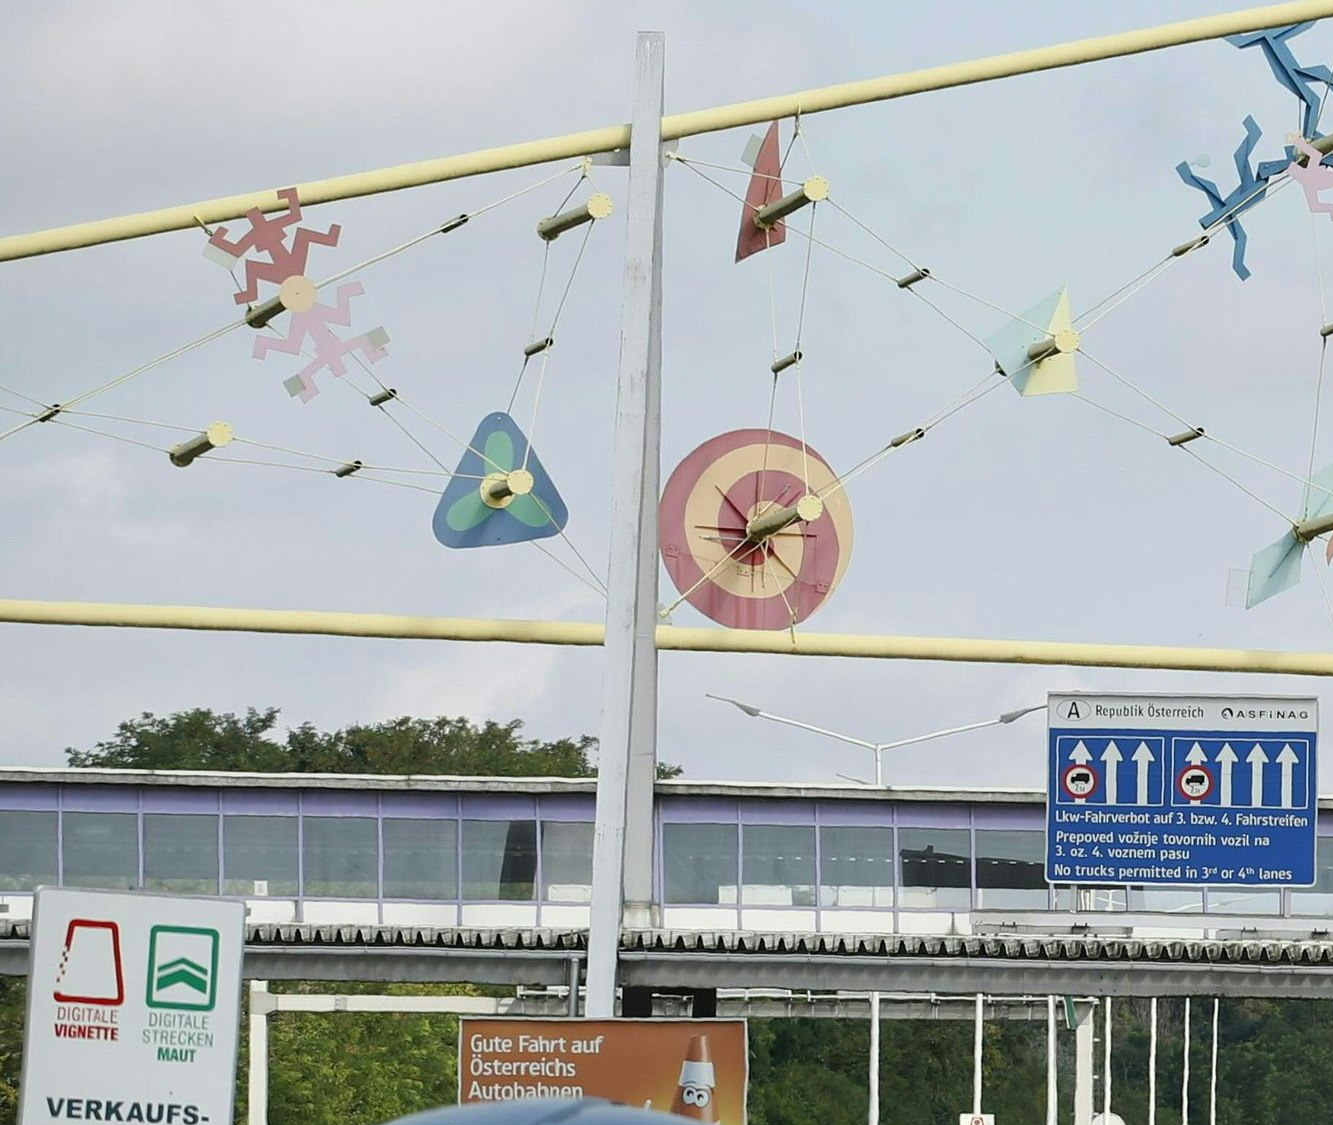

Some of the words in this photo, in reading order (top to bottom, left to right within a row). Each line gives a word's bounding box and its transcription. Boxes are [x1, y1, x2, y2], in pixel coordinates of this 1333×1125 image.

[1067, 701, 1080, 719] A
[1095, 704, 1144, 720] Republik
[1148, 703, 1204, 719] Österreich
[1055, 811, 1151, 824] Lkw-Fahrverbot
[1153, 812, 1173, 825] auf
[1176, 813, 1186, 825] 3.
[1190, 813, 1218, 826] bzw.
[1220, 813, 1232, 826] 4.
[1236, 813, 1309, 827] Fahrstreifen
[1056, 831, 1114, 846] Prepoved
[1118, 831, 1159, 846] vožnje
[1163, 833, 1216, 846] tovornih
[1221, 833, 1250, 847] vozil
[1254, 836, 1270, 847] na
[1056, 846, 1066, 857] 3.
[1070, 848, 1088, 858] oz.
[1092, 847, 1103, 858] 4.
[1107, 849, 1155, 859] voznem
[1160, 849, 1190, 861] pasu
[1054, 864, 1071, 877] No
[1075, 864, 1115, 877] trucks
[1119, 865, 1181, 880] permitted
[1186, 866, 1197, 879] in
[1221, 869, 1234, 879] or
[1259, 867, 1292, 880] lanes
[57, 1006, 119, 1024] DIGITALE
[149, 1012, 210, 1030] DIGITALE
[54, 1023, 119, 1041] VIGNETTE
[142, 1029, 214, 1047] STRECKEN
[470, 1034, 513, 1053] Gute
[518, 1035, 566, 1053] Fahrt
[570, 1036, 604, 1054] auf
[157, 1047, 197, 1063] MAUT
[470, 1054, 576, 1078] Österreichs
[468, 1081, 583, 1100] Autobahnen
[46, 1097, 209, 1125] VERKAUFS-
